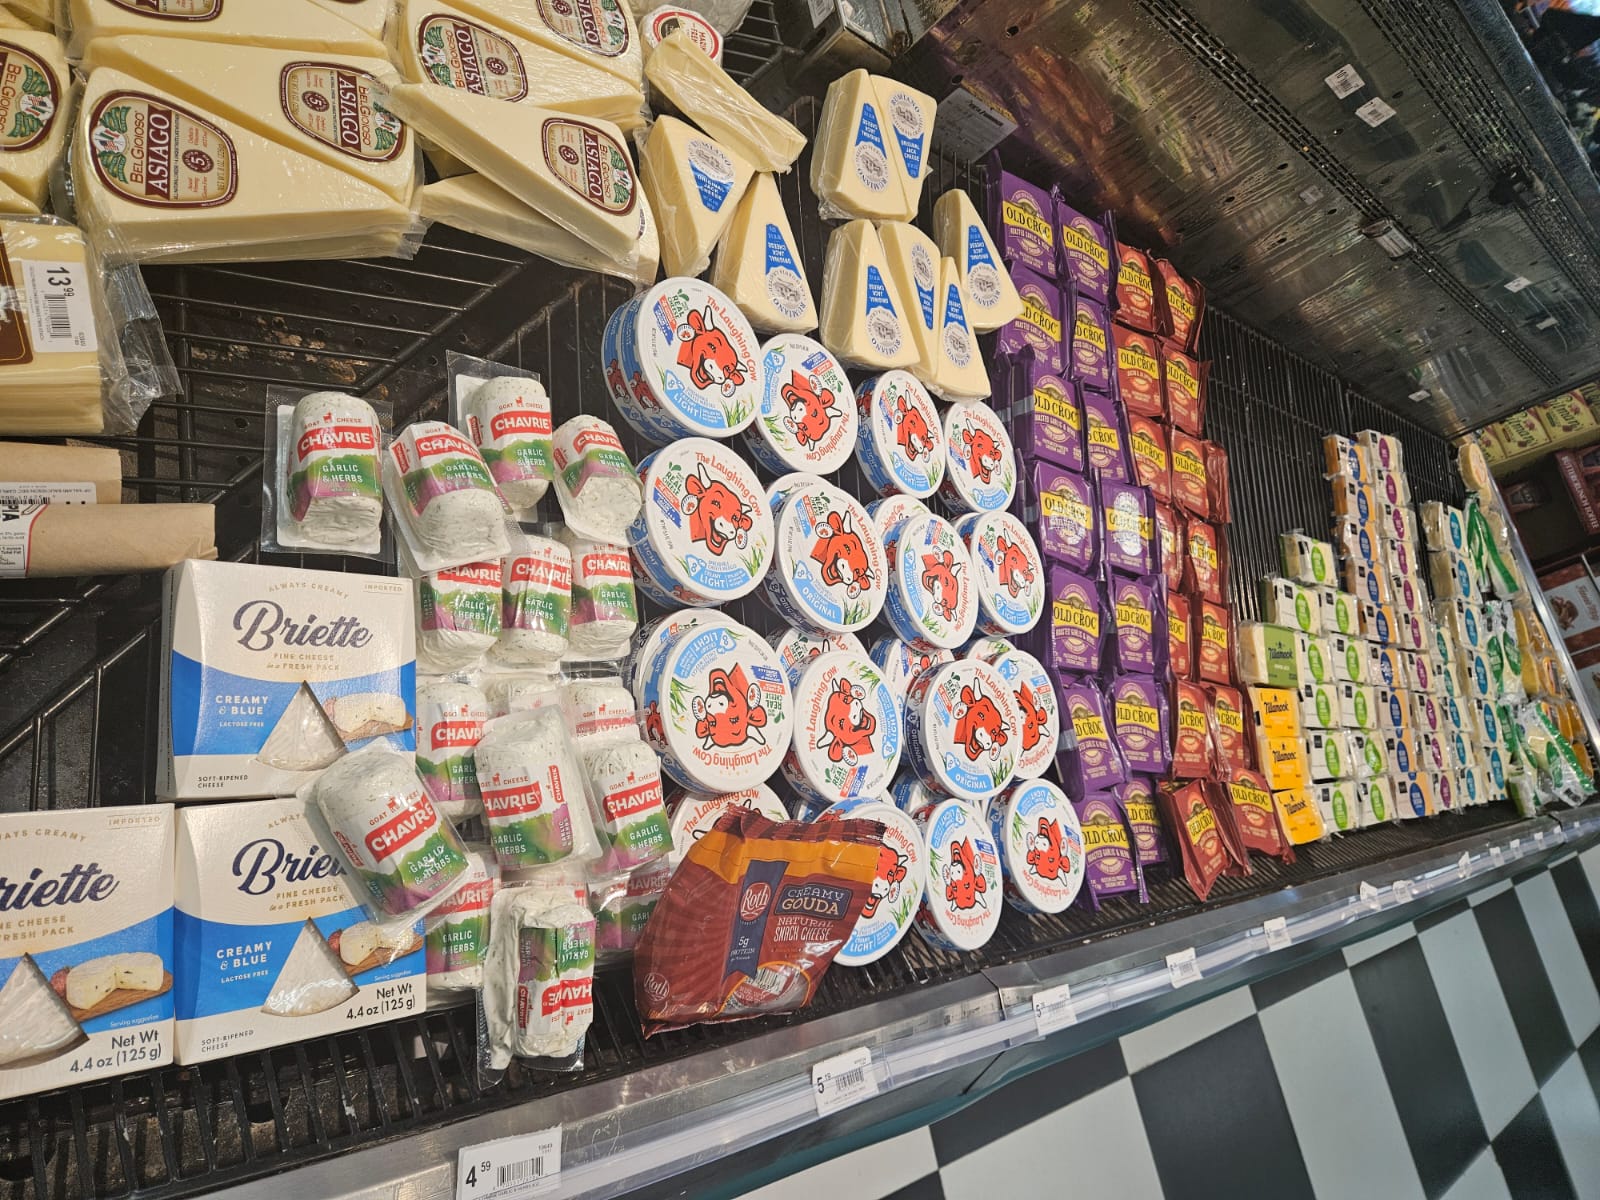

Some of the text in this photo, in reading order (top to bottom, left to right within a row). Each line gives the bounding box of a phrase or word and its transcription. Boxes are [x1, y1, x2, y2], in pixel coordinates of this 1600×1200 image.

[455, 28, 484, 94] ASIAGO
[339, 76, 360, 145] ASIAGO
[148, 113, 170, 194] ASIAGO
[585, 136, 603, 196] ASIAGO
[1006, 206, 1026, 226] OLD
[1026, 216, 1051, 240] CROC
[768, 242, 787, 250] CHEESE
[1066, 230, 1084, 248] OLD
[1084, 240, 1106, 262] CROC
[1135, 272, 1152, 291] CROC
[64, 288, 74, 297] 99
[672, 296, 686, 318] REAL
[1035, 311, 1058, 334] CROC
[707, 296, 758, 382] The Laughing Cow
[1082, 326, 1104, 344] CROC
[1120, 352, 1155, 373] OLD CROC
[1166, 364, 1196, 390] OLD CROC
[674, 394, 698, 417] LIGHT
[1052, 400, 1078, 420] CROC
[494, 416, 551, 432] CHAVRIE
[300, 431, 372, 450] CHAVRIE
[1094, 430, 1116, 444] CROC
[516, 448, 544, 458] GARLIC
[1143, 442, 1164, 461] CROC
[322, 464, 358, 472] GARLIC
[446, 464, 478, 473] GARLIC
[1175, 454, 1190, 468] OLD
[332, 474, 364, 484] HERBS
[666, 472, 682, 490] REAL
[696, 452, 762, 517] The Laughing Cow
[1561, 455, 1589, 508] BUTTERCRUNCH
[1584, 506, 1600, 529] TOFFEE
[642, 542, 658, 566] LIGHT
[847, 502, 882, 590] The Laughing Cow
[516, 563, 572, 586] CHAVRIE
[700, 574, 726, 587] LIGHT
[268, 582, 350, 600] ALWAYS CREAMY
[364, 584, 402, 592] IMPORTED
[602, 590, 626, 600] GARLIC
[526, 598, 553, 610] GARLIC
[802, 588, 836, 620] ORIGINAL
[458, 611, 486, 620] HERBS
[1054, 606, 1098, 630] OLD CROC
[1130, 611, 1150, 626] CROC
[232, 600, 373, 651] Briette
[696, 632, 718, 649] LIGHT
[1268, 649, 1293, 660] Tillamook
[282, 662, 312, 670] FRESH
[216, 694, 268, 705] CREAMY
[765, 700, 782, 710] REAL
[974, 668, 1018, 736] The Laughing Cow
[1264, 701, 1289, 714] Tillamook
[232, 706, 264, 716] BLUE
[808, 664, 838, 752] The Laughing Cow
[1132, 712, 1156, 725] CROC
[1185, 714, 1204, 728] CROC
[1220, 714, 1240, 727] CROC
[1086, 720, 1102, 734] CROC
[911, 728, 923, 762] ORIGINAL
[692, 744, 772, 769] The Laughing Cow
[1272, 750, 1298, 764] Tillamook
[198, 774, 248, 782] SOFT-RIPENED
[504, 776, 528, 786] CHEESE
[608, 771, 658, 791] GOAT CHEESE
[832, 765, 846, 786] REAL
[955, 774, 988, 790] ORIGINAL
[1232, 788, 1269, 806] OLD CROC
[369, 812, 388, 826] GOAT
[683, 820, 698, 834] The
[35, 828, 87, 842] CREAMY
[630, 824, 660, 840] GARLIC
[1084, 828, 1127, 845] OLD CROC
[1190, 822, 1201, 836] OLD
[500, 844, 527, 855] HERBS
[638, 834, 664, 850] HERBS
[906, 840, 919, 864] Cow
[276, 886, 338, 900] FINE CHEESE
[742, 884, 770, 910] Roth
[788, 886, 845, 902] CREAMY
[286, 894, 344, 909] FRESH PACK
[782, 898, 839, 916] GOUDA
[18, 915, 66, 928] CHEESE
[776, 917, 834, 929] NATURAL
[42, 926, 74, 936] PACK
[442, 930, 473, 944] GARLIC
[774, 926, 832, 943] SNACK CHEESE
[216, 940, 272, 959] CREAMY
[738, 936, 750, 948] 5g
[850, 939, 874, 952] LIGHT
[233, 954, 268, 968] BLUE
[220, 970, 269, 984] LACTOSE FREE
[376, 983, 413, 1001] Net Wt
[644, 974, 670, 999] Roth
[346, 994, 416, 1020] 4.4 oz (125 g)
[111, 1030, 159, 1050] Net Wt
[201, 1029, 254, 1046] SOFT-RIPENED
[201, 1042, 230, 1052] CHEESE
[69, 1042, 162, 1073] 4.4 oz (125 g)
[466, 1160, 492, 1188] 4 59
